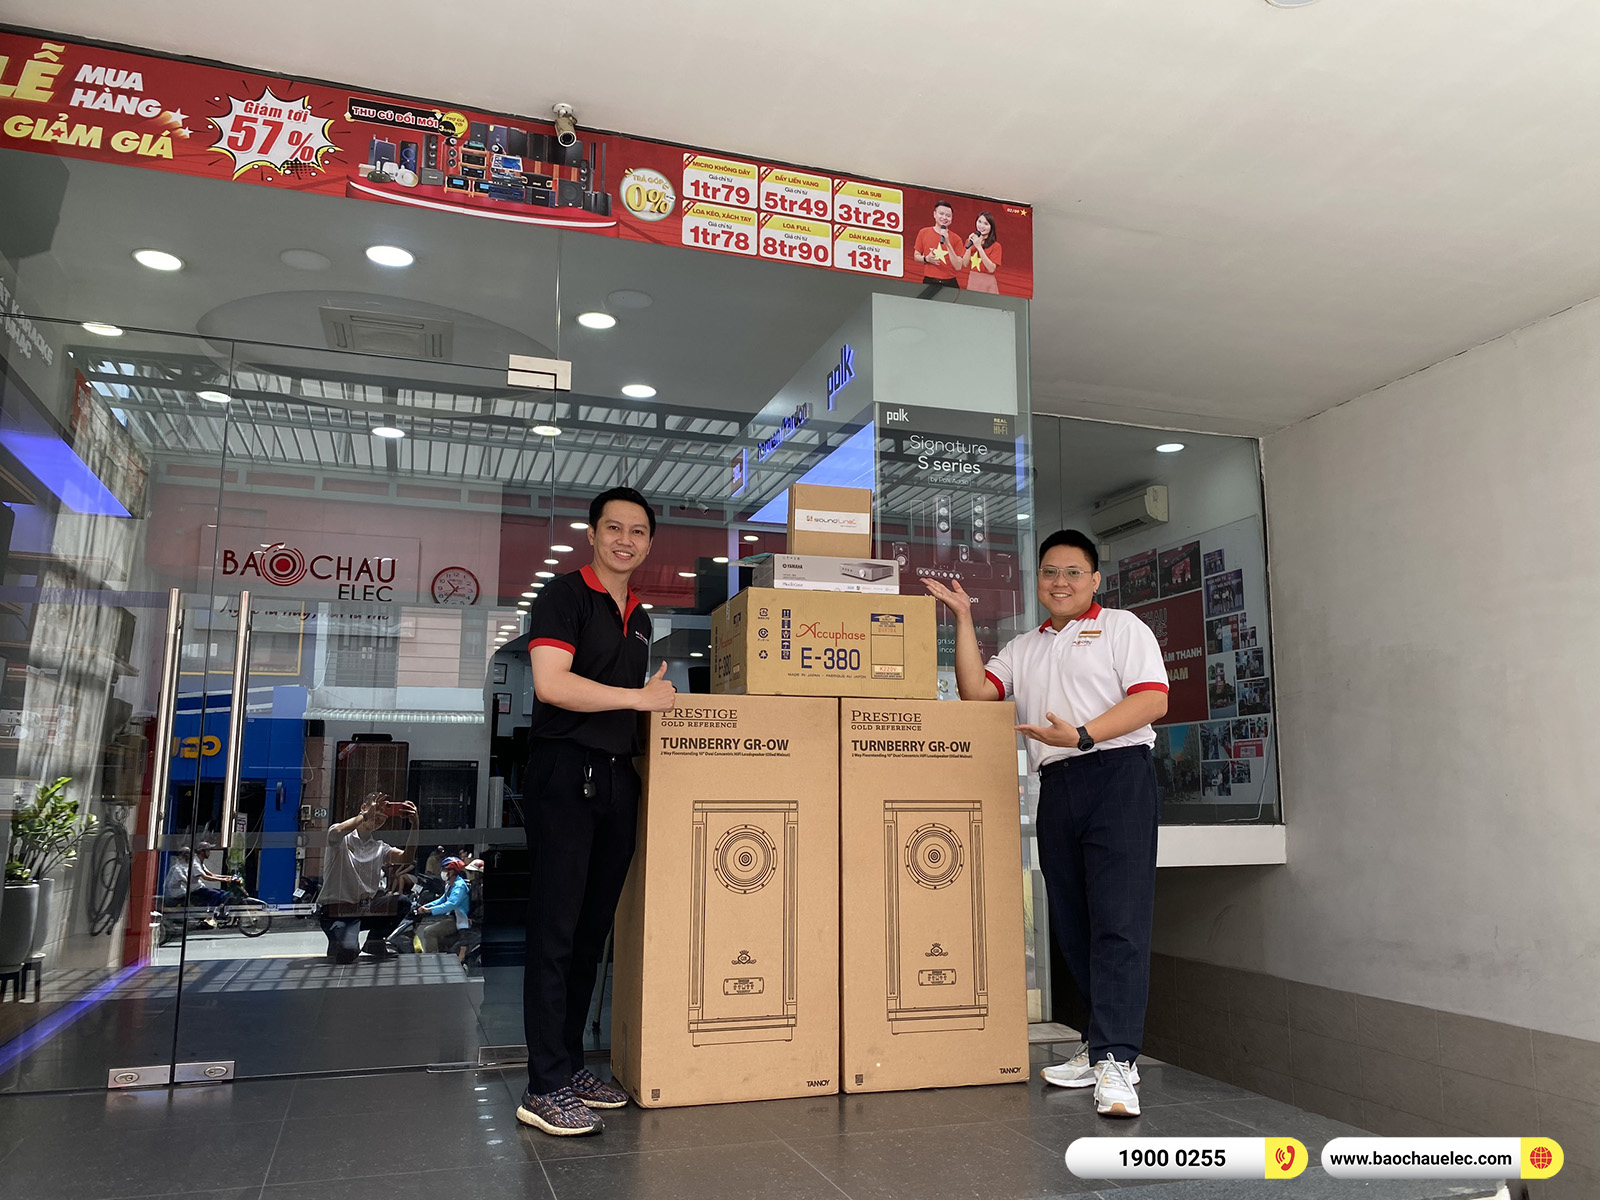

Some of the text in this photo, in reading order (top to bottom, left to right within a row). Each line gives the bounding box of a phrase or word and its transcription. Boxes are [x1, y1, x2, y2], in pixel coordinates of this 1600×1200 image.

[75, 64, 143, 91] MUA
[69, 87, 162, 118] HÀNG
[243, 100, 309, 123] Giảm tới
[351, 106, 376, 118] THU
[3, 113, 174, 159] GIẢM GIÁ
[692, 161, 750, 176] MICRO KHÔNG DÂY
[690, 179, 750, 205] 1tr79
[802, 180, 819, 188] VANG
[625, 183, 669, 214] 0%
[764, 191, 828, 218] 5tr49
[722, 211, 739, 220] XÁCH
[838, 204, 900, 229] 3tr29
[690, 226, 750, 251] 1tr78
[862, 235, 890, 244] KARAOKE
[763, 237, 829, 263] 8tr90
[847, 250, 891, 272] 13tr
[827, 343, 856, 411] polk
[886, 408, 909, 424] polk
[909, 435, 988, 456] Signature
[918, 456, 981, 474] S series
[337, 583, 394, 602] ELEC
[795, 621, 866, 647] Accuphase
[800, 647, 860, 671] E-380
[1176, 647, 1202, 660] THANH
[851, 709, 922, 723] PRESTIGE
[660, 737, 789, 751] TURNBERRY GR-OW
[851, 740, 971, 753] TURNBERRY GR-OW
[999, 1066, 1021, 1074] TANNOY
